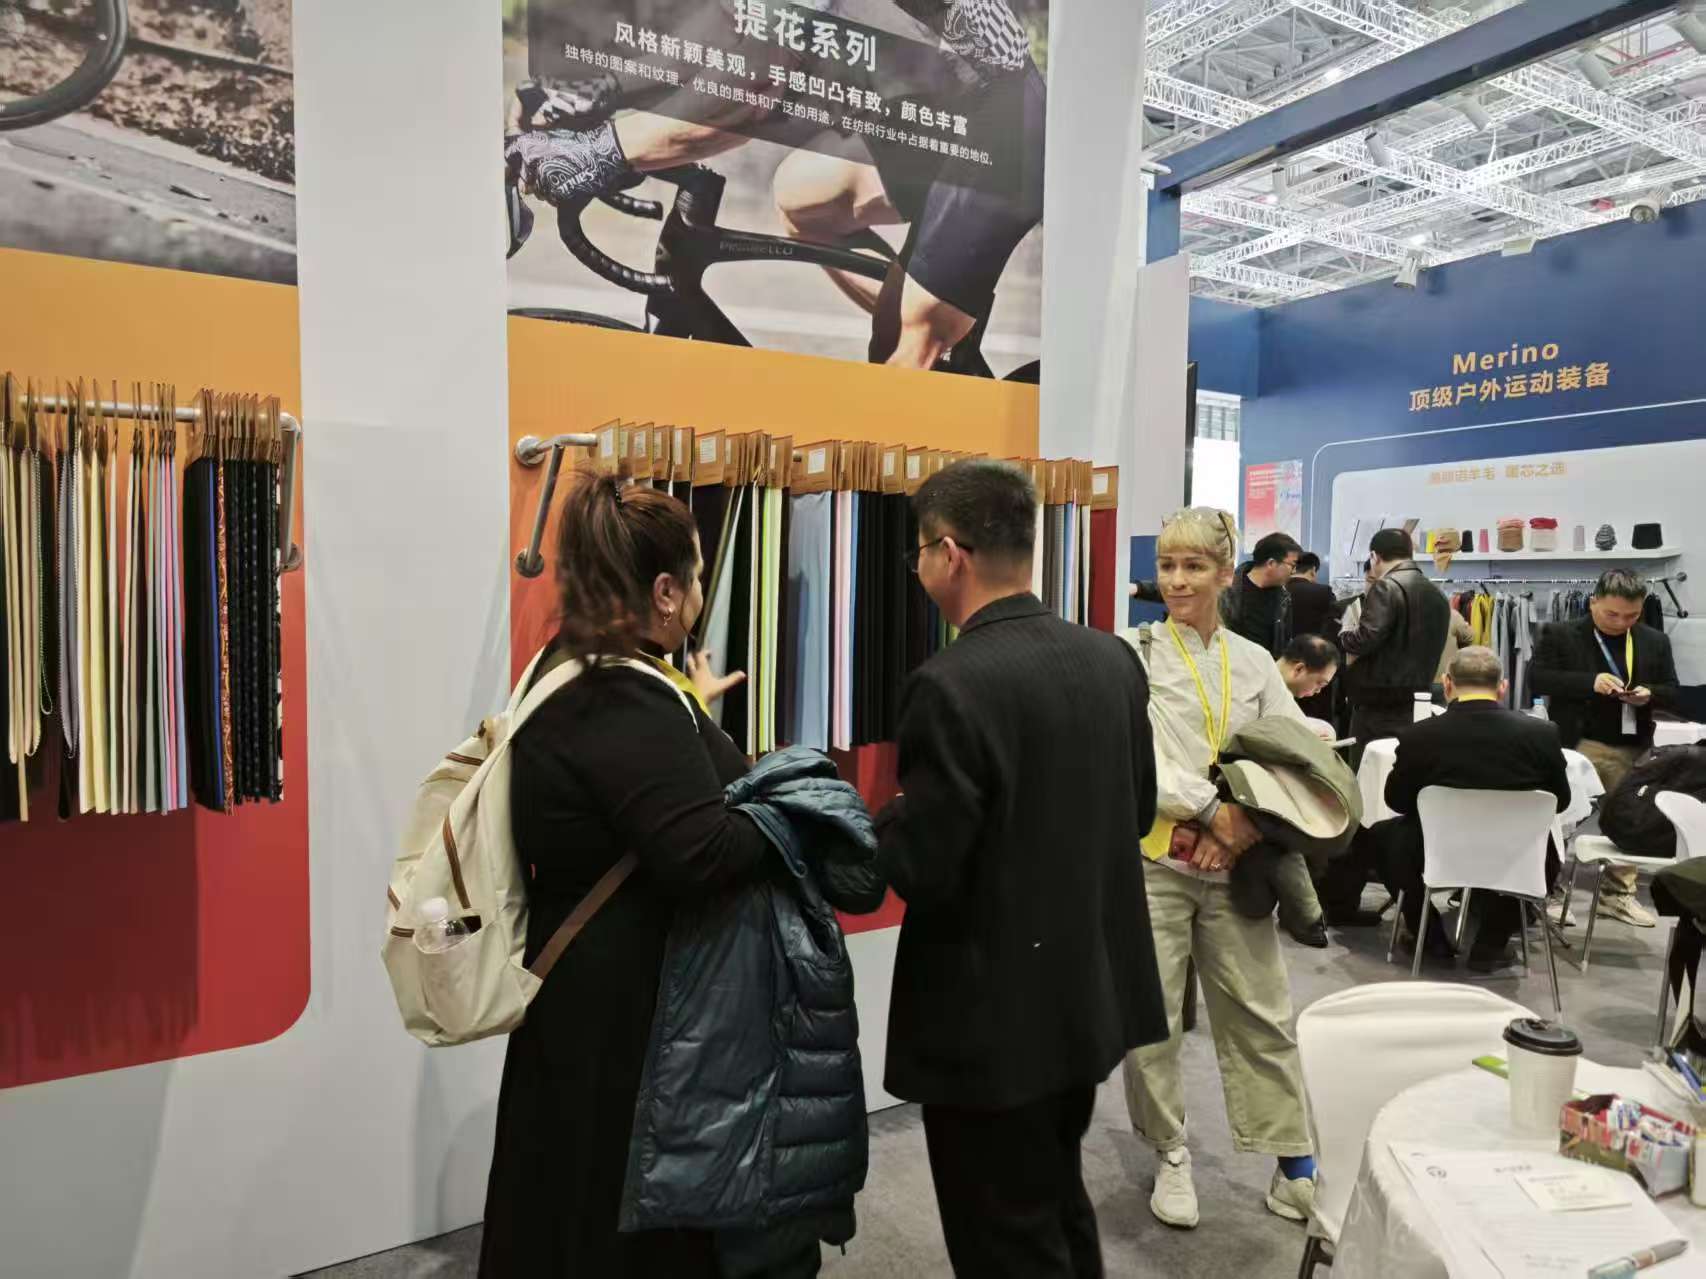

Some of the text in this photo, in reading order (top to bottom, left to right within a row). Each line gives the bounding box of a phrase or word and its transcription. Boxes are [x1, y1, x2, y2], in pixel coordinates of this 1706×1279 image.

[733, 0, 876, 72] 提花系列
[1452, 343, 1559, 375] Merino
[1409, 361, 1610, 412] 顶级户外运动装备
